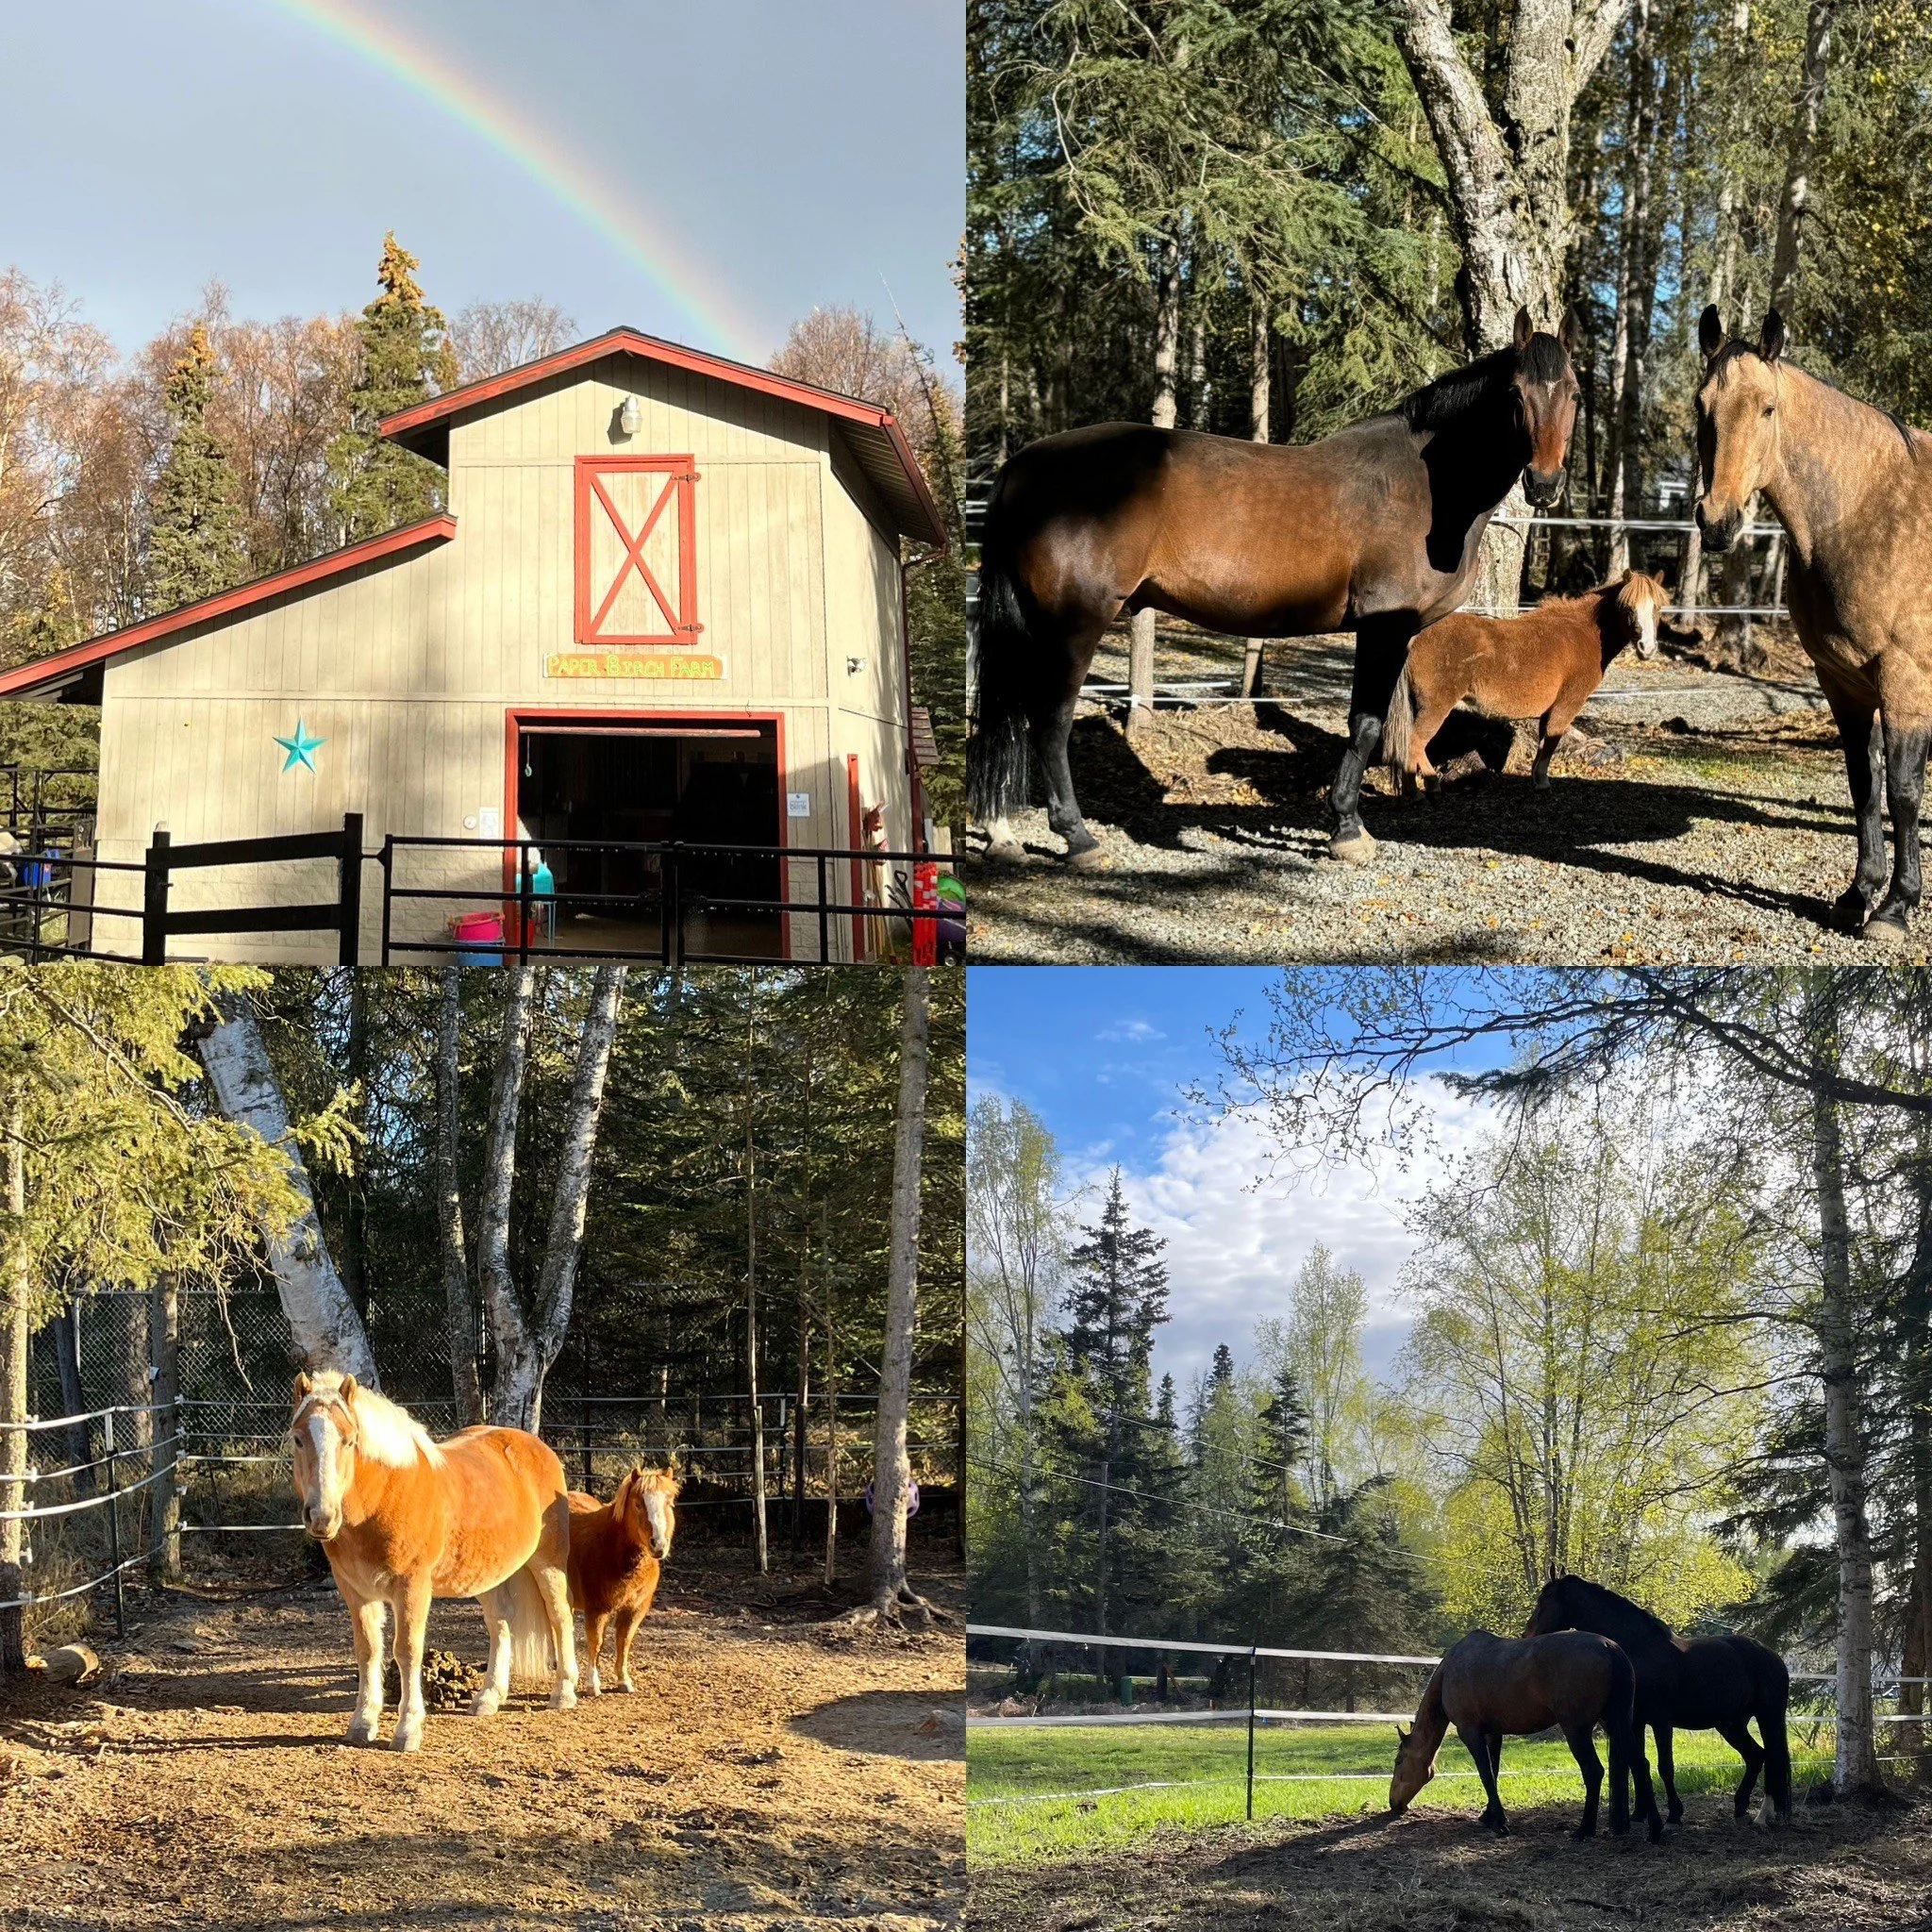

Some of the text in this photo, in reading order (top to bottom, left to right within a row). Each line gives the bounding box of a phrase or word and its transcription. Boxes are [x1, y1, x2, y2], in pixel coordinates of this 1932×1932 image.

[547, 655, 715, 677] PAPER BIRCH FARM
